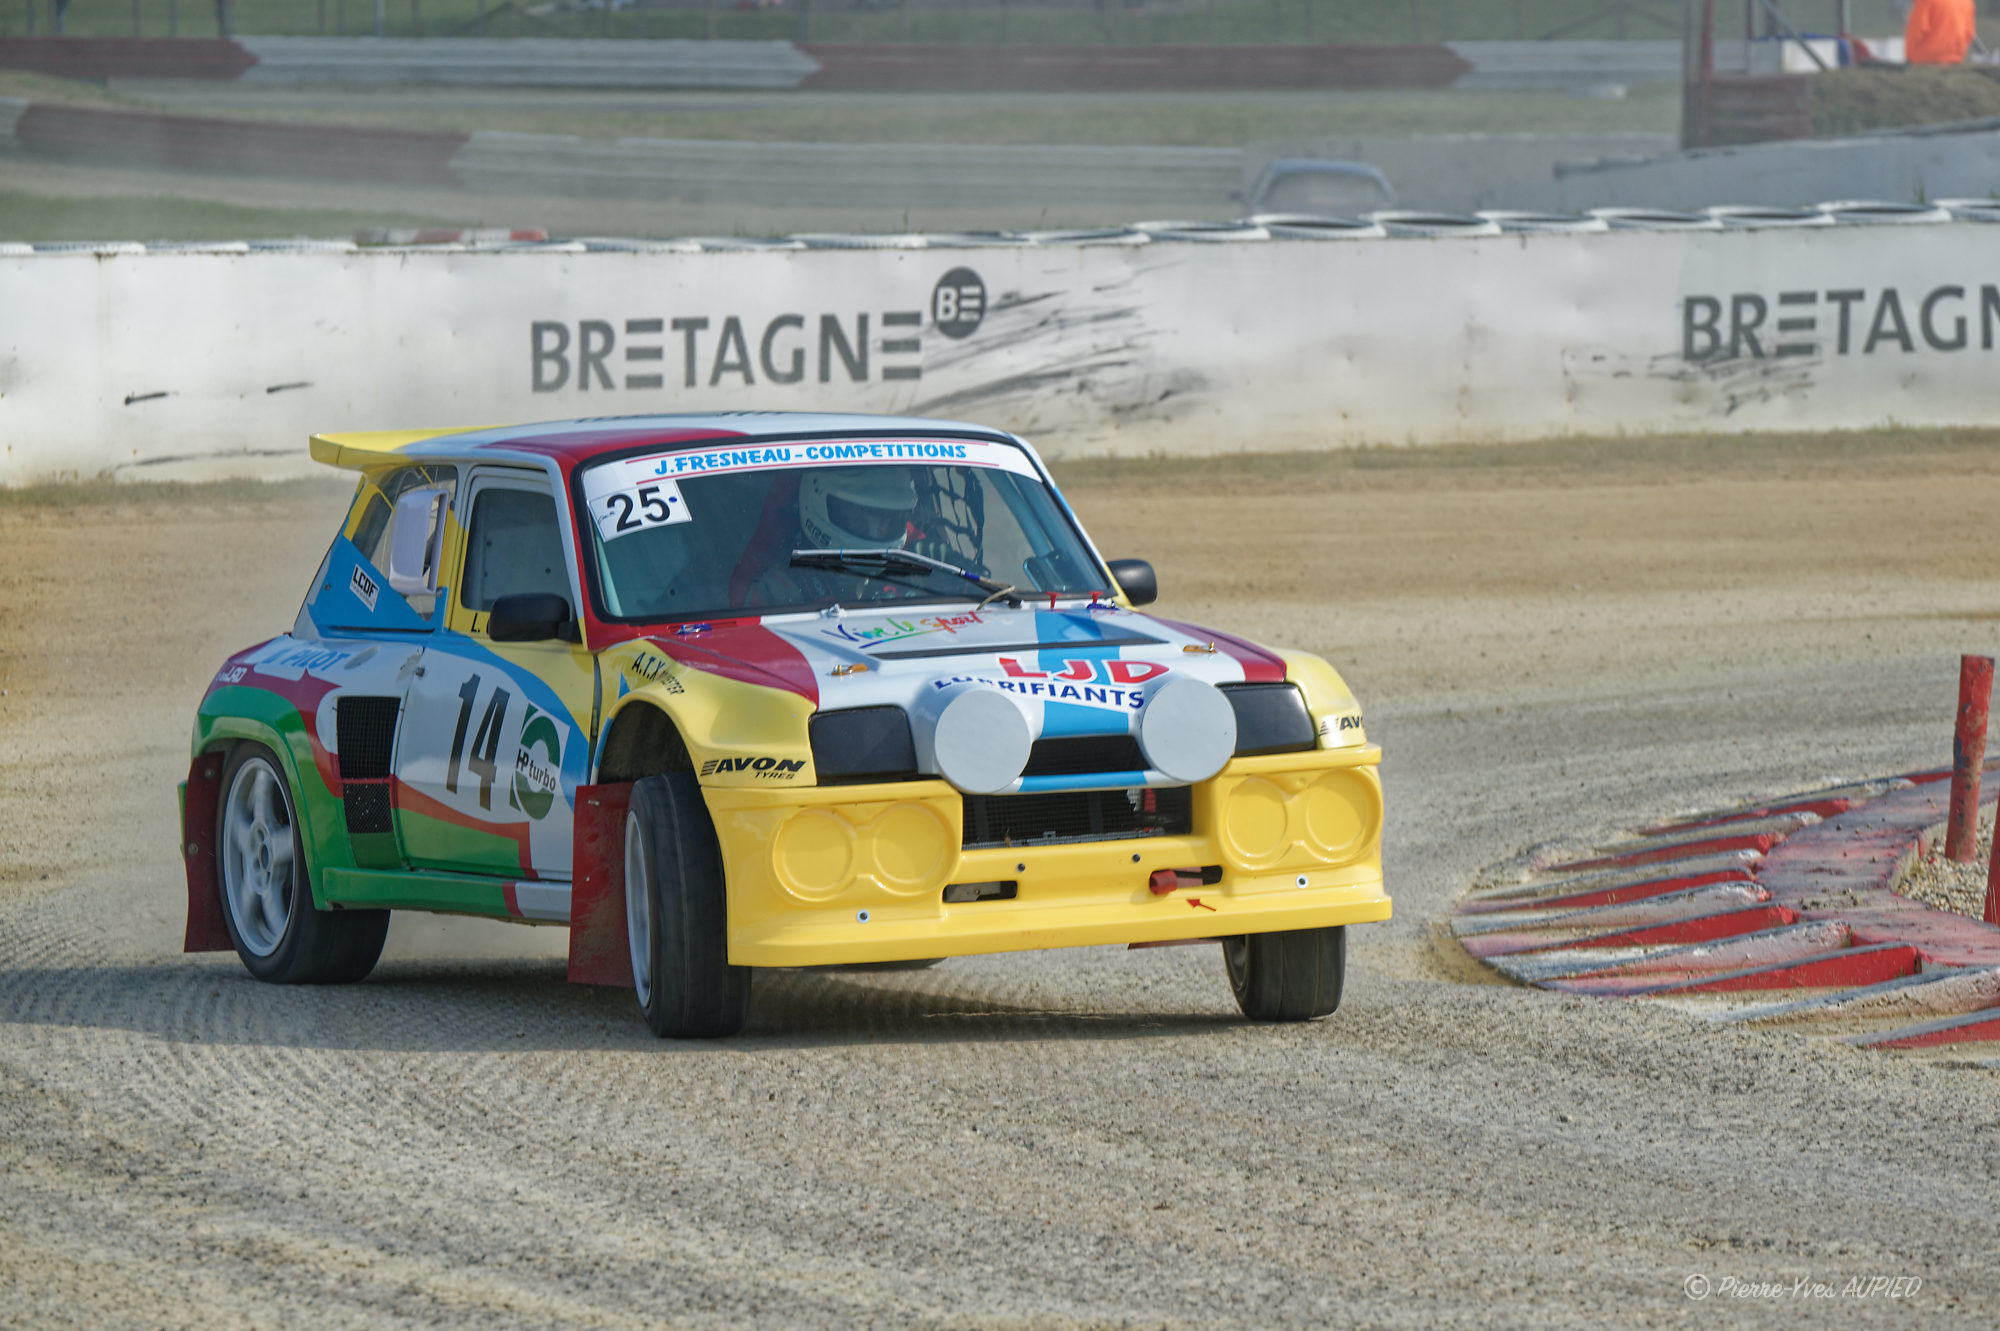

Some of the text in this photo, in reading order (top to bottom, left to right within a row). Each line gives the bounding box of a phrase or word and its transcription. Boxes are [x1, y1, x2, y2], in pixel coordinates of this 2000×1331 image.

[936, 284, 984, 323] BE
[531, 311, 922, 393] BRETAGNE
[805, 443, 967, 460] COMPETITIONS
[607, 486, 671, 533] 25
[999, 657, 1170, 684] LJD
[446, 672, 511, 812] 14
[528, 760, 556, 791] turbo
[715, 757, 806, 774] AVON
[755, 772, 795, 780] TYRES
